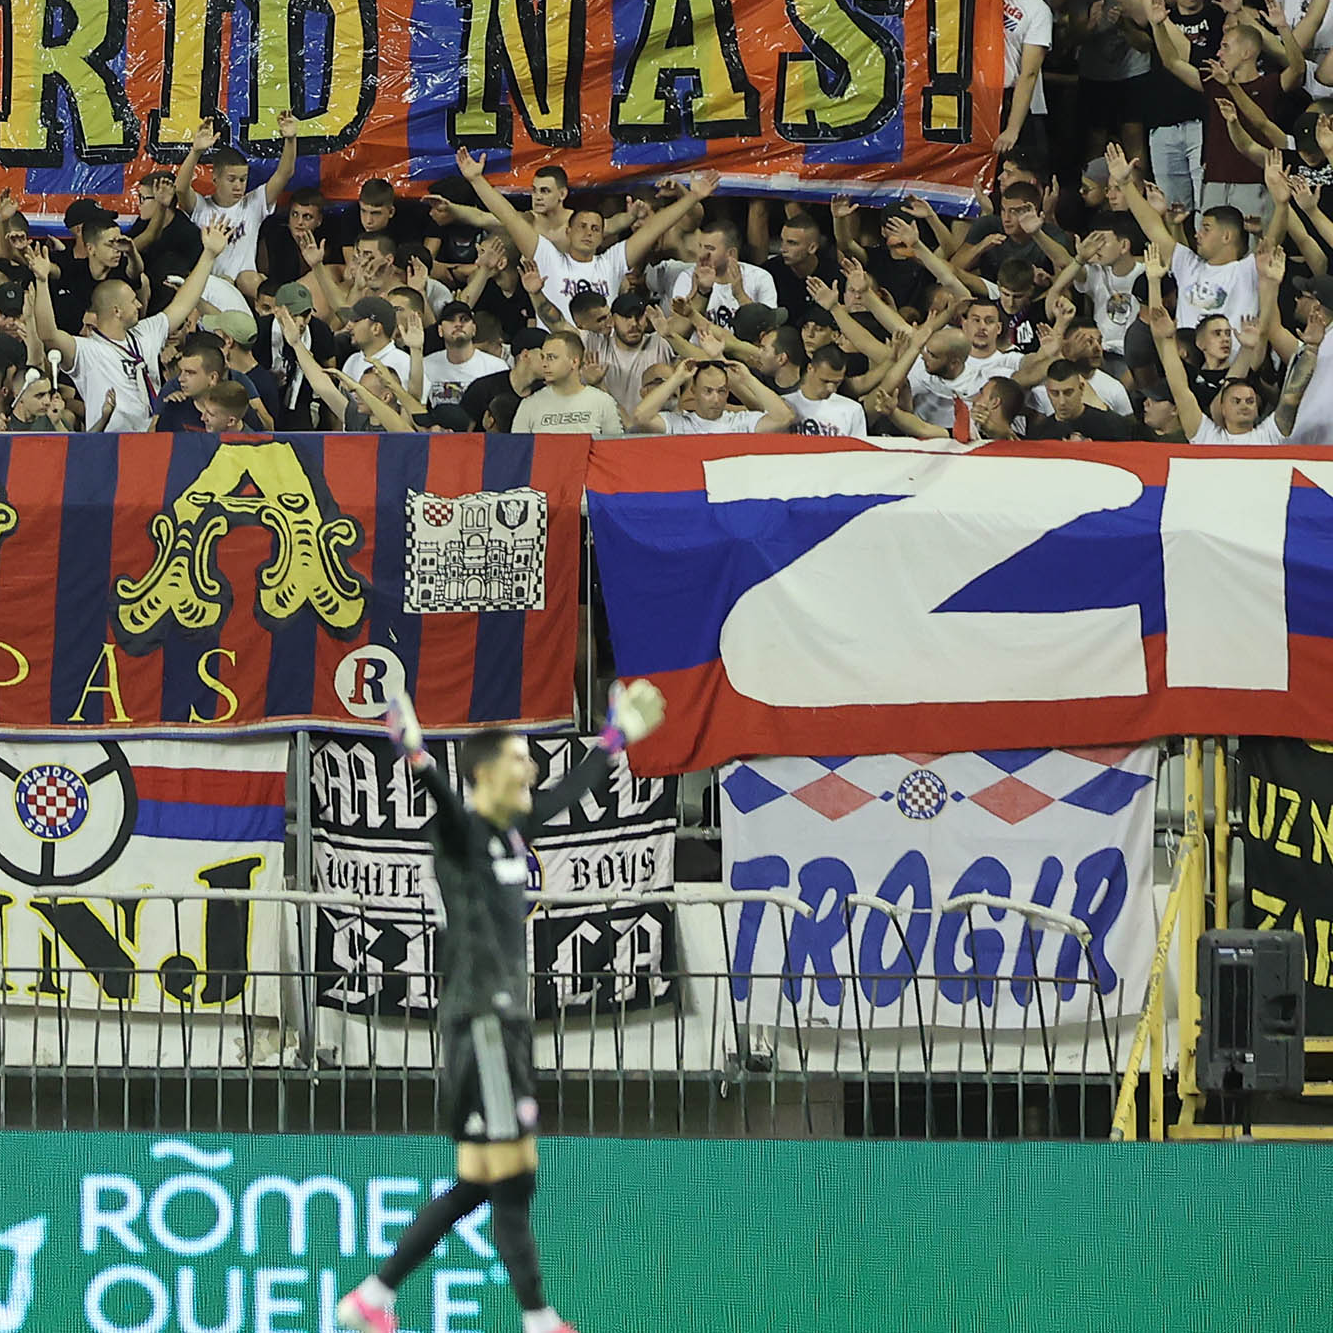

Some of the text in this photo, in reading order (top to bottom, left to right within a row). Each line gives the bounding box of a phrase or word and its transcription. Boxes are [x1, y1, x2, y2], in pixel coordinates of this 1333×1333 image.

[540, 410, 592, 428] GUESS
[21, 766, 83, 795] HAJDUK
[902, 769, 943, 789] HAJDUK
[24, 817, 73, 838] SPLIT
[325, 847, 657, 899] WHITE BOYS
[730, 847, 1129, 1009] TROGIR
